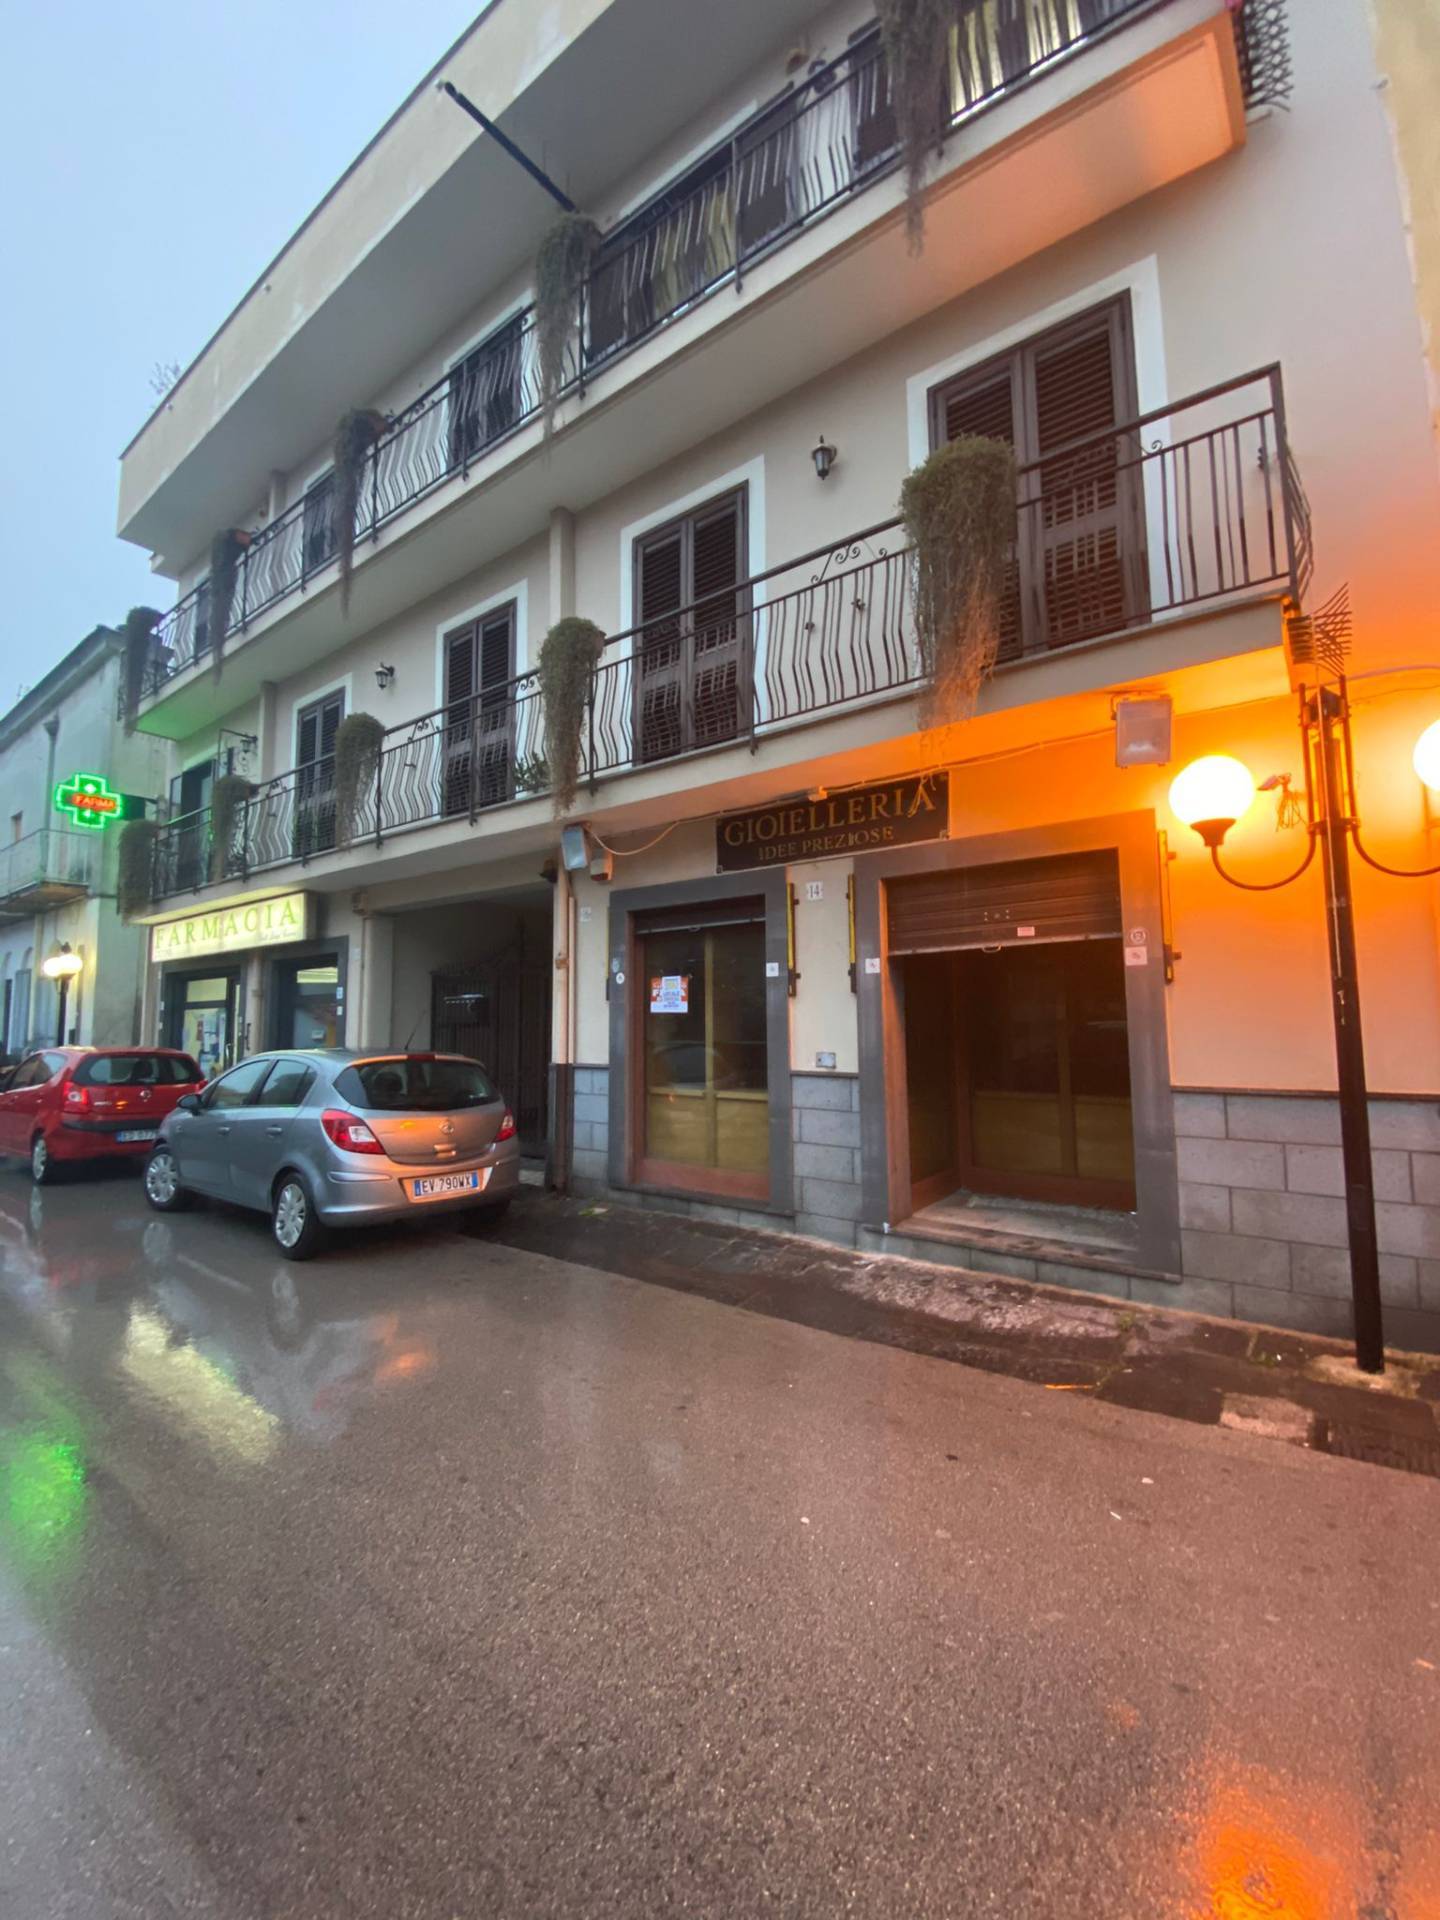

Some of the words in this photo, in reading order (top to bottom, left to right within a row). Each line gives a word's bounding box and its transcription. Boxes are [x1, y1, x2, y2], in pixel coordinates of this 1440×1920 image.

[724, 783, 936, 847] GIOIELLERIA
[759, 840, 798, 860] IDEE
[802, 825, 894, 854] PREZIOSE
[810, 884, 820, 898] 14
[156, 900, 297, 949] FARMACIA
[422, 1178, 435, 1193] EV
